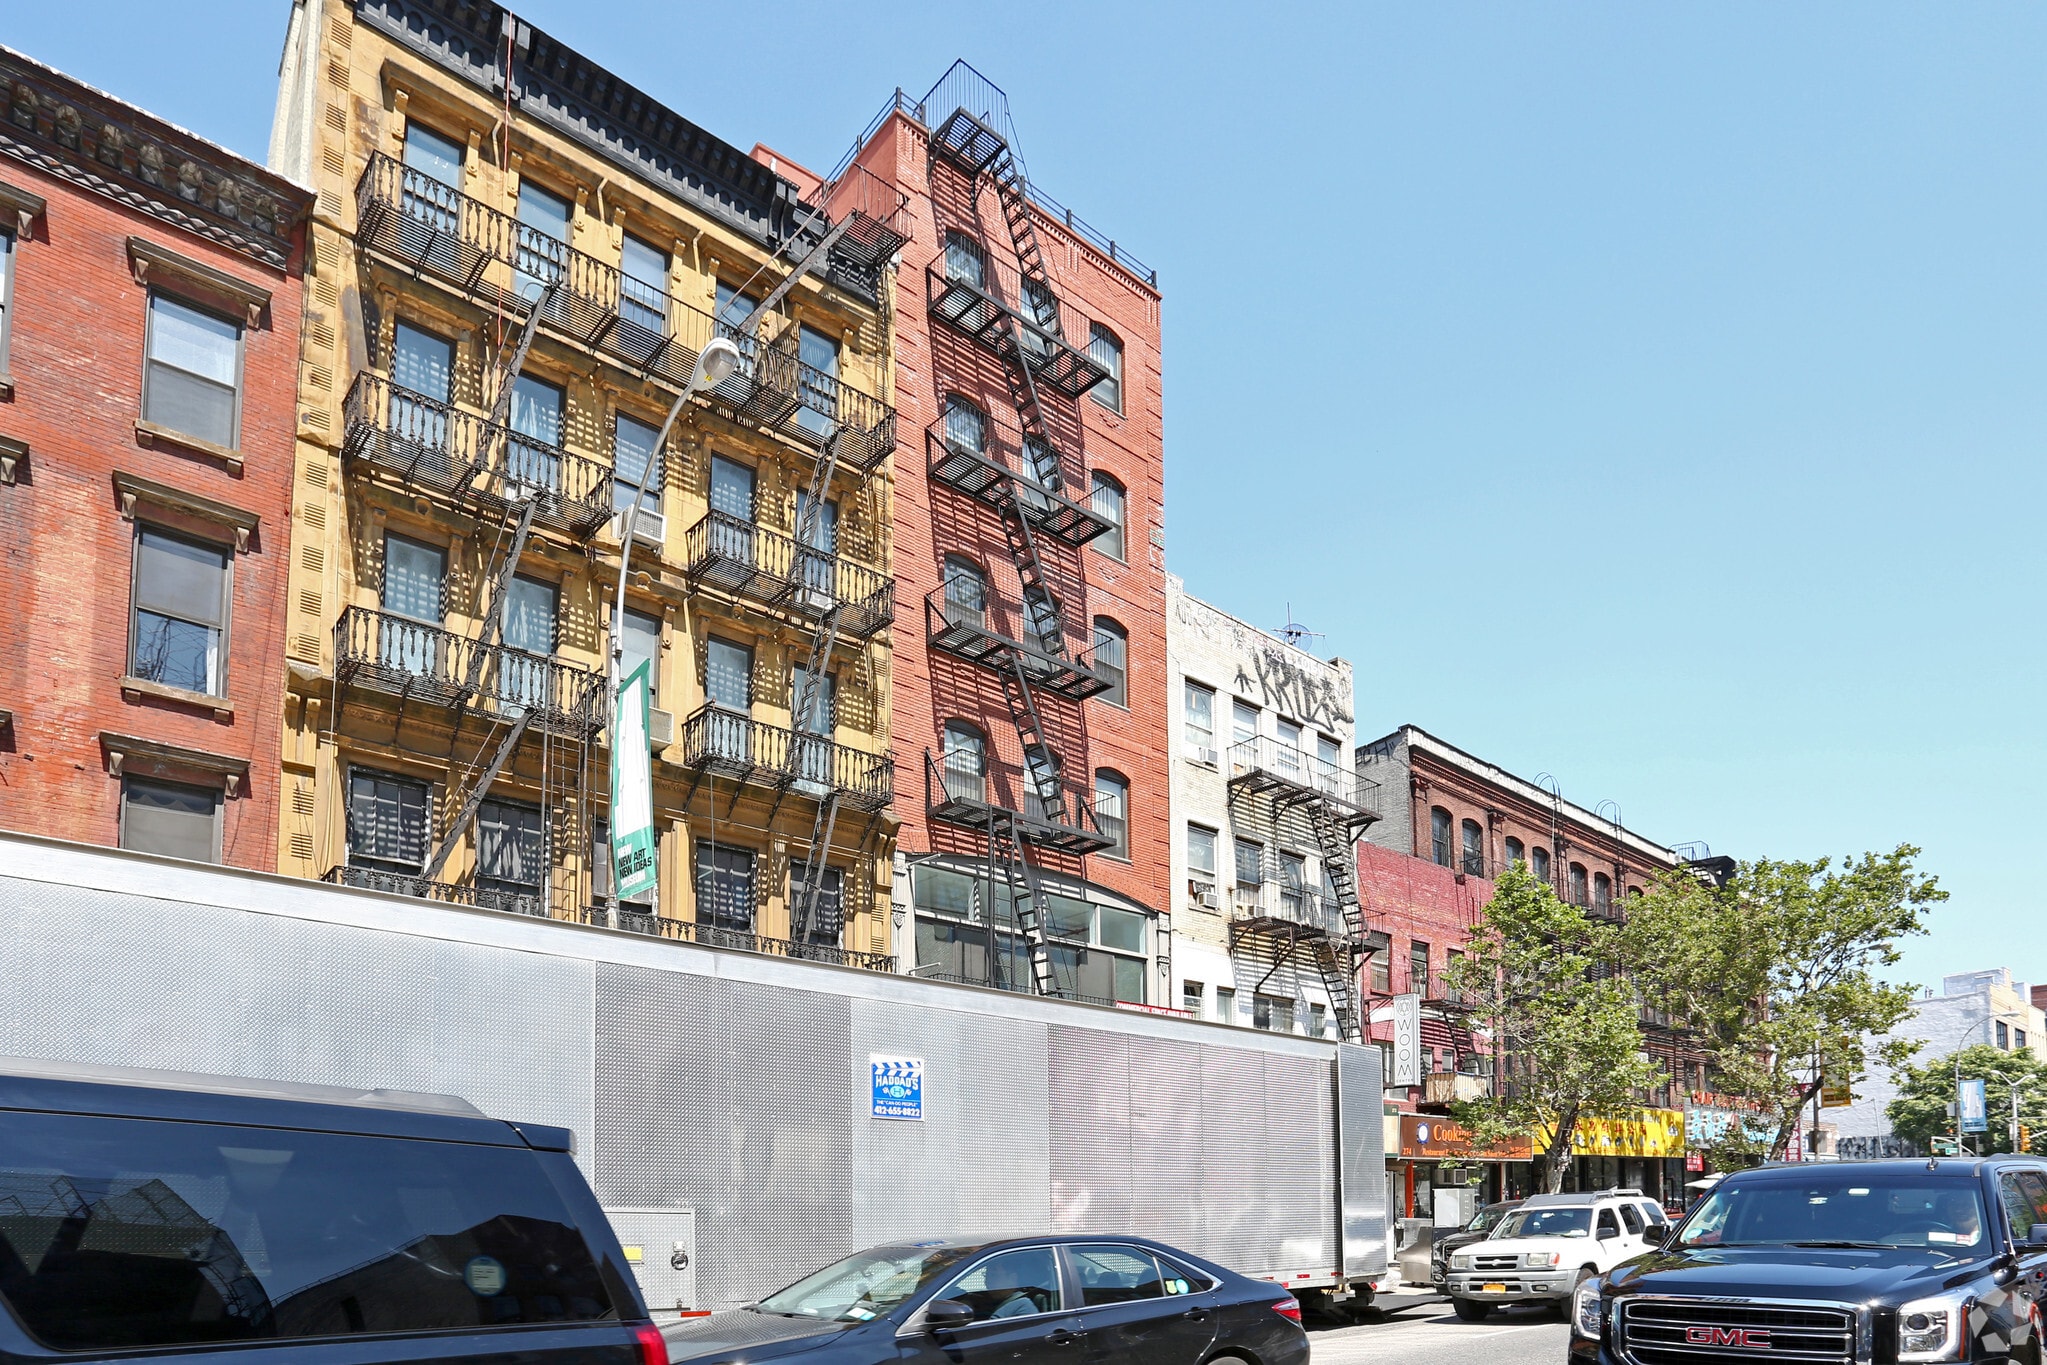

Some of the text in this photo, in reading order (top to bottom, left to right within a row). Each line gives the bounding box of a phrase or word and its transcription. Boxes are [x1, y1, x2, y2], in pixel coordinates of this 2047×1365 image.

[618, 848, 647, 868] NEW ART
[619, 856, 653, 880] NEW IDEAS
[1397, 1018, 1413, 1077] WOOM
[875, 1075, 919, 1090] HADDAD'S
[1686, 1326, 1772, 1348] GMC
